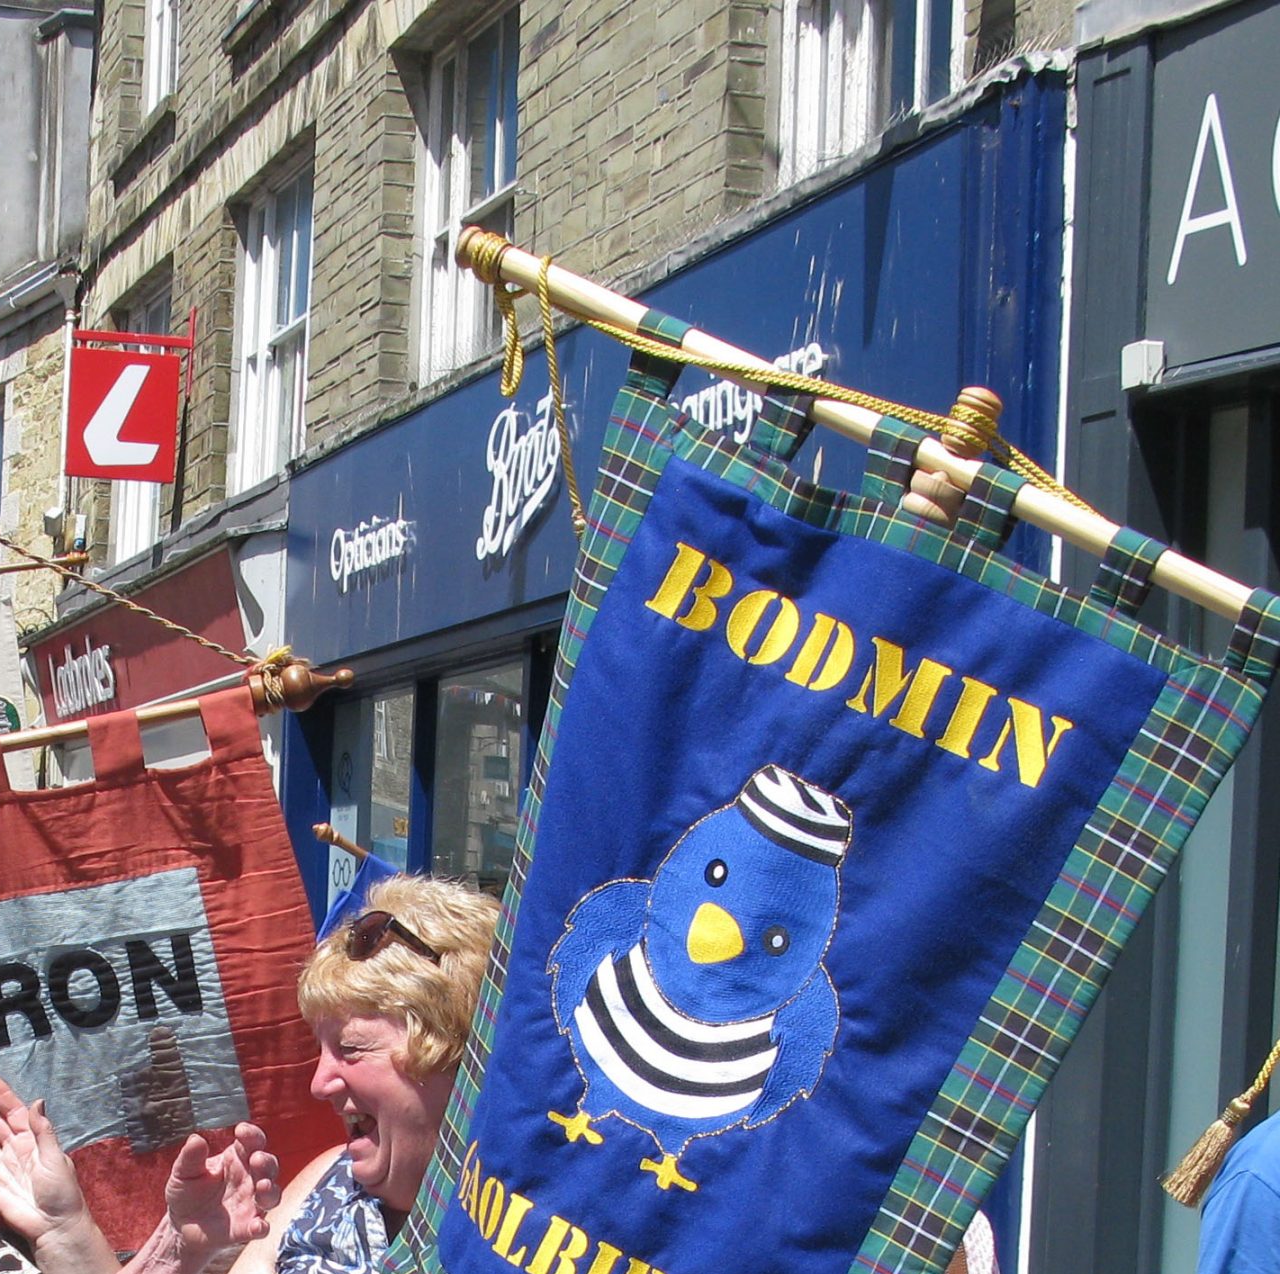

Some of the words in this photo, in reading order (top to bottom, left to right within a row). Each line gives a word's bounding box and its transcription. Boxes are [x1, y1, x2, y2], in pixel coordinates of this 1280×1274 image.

[1167, 93, 1280, 284] A
[330, 515, 410, 593] Opticians
[48, 634, 114, 718] Ladbrokes
[644, 541, 1074, 788] BODMIN
